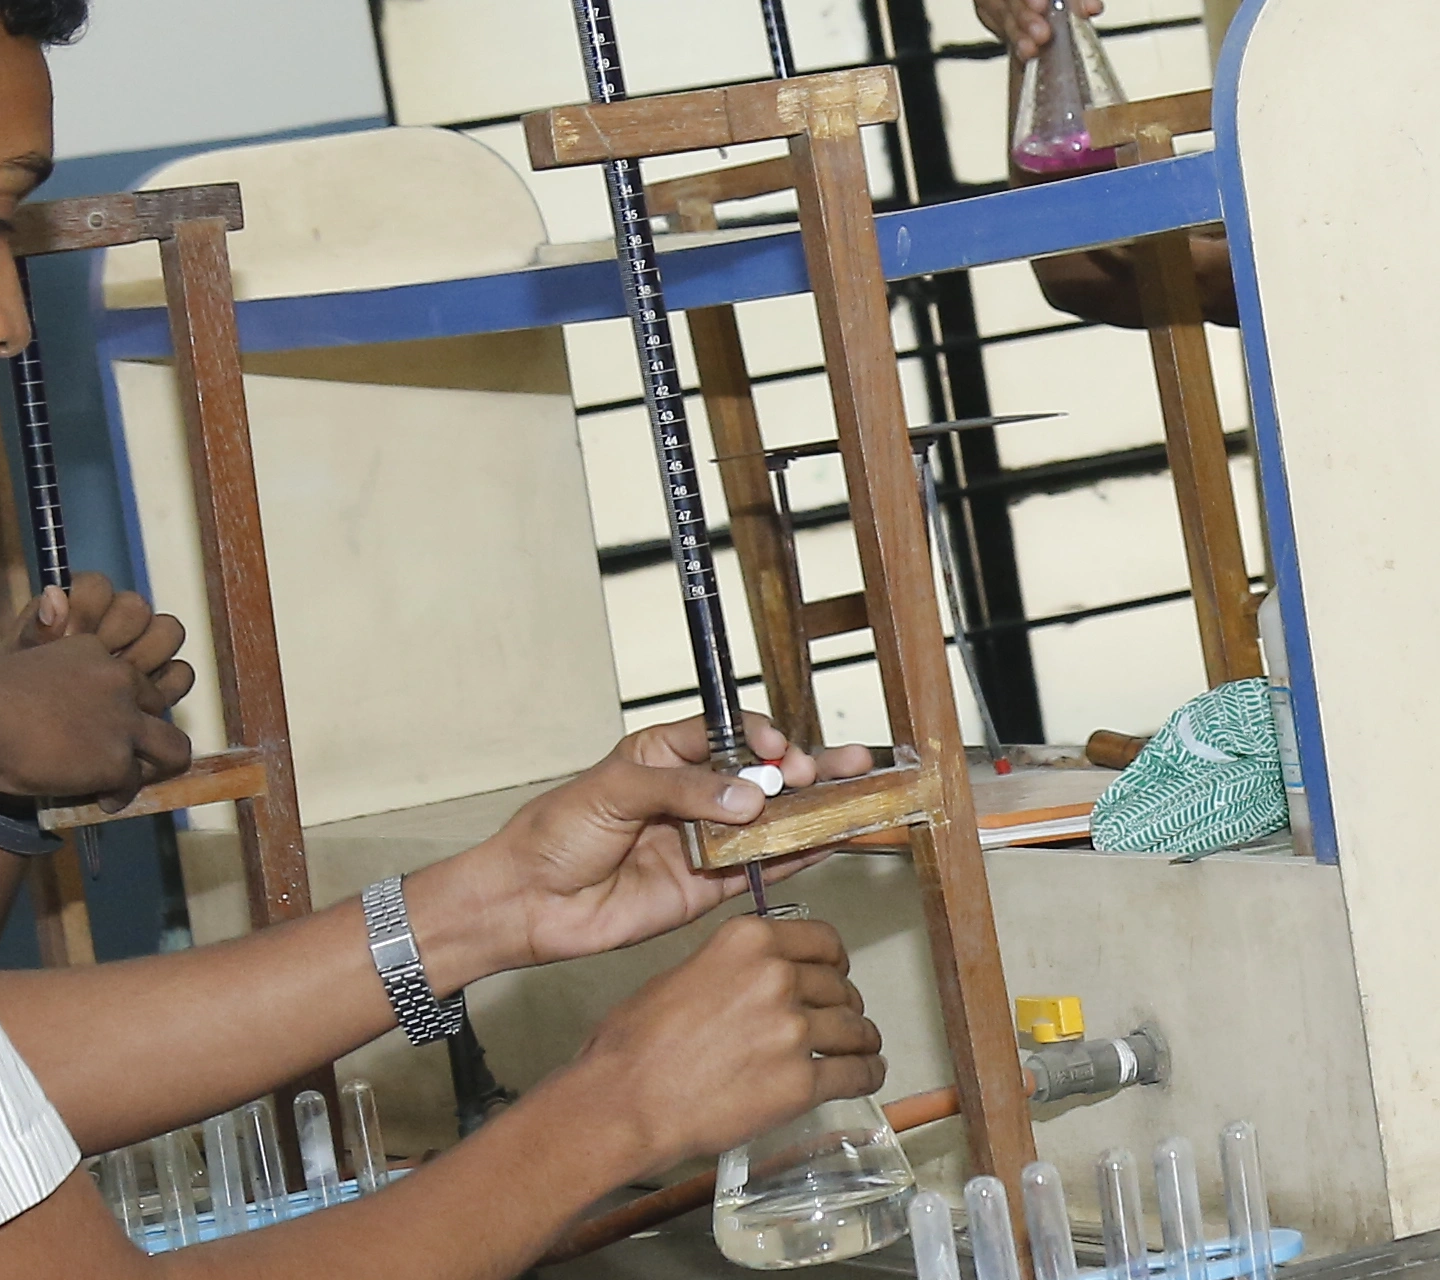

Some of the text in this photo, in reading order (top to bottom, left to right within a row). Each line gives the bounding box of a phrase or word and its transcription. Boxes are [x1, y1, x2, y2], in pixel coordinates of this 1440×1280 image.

[614, 159, 629, 170] 33
[620, 184, 633, 195] 34
[624, 209, 638, 220] 35
[628, 234, 642, 245] 36
[633, 259, 647, 270] 37
[637, 284, 651, 295] 38
[642, 310, 656, 321] 39
[646, 334, 660, 345] 40
[651, 360, 664, 371] 41
[655, 385, 669, 396] 42
[660, 410, 674, 421] 43
[664, 434, 678, 446] 44
[669, 460, 683, 471] 45
[673, 485, 687, 496] 46
[677, 510, 691, 521] 47
[682, 535, 696, 546] 48
[686, 560, 701, 571] 49
[691, 585, 705, 596] 50
